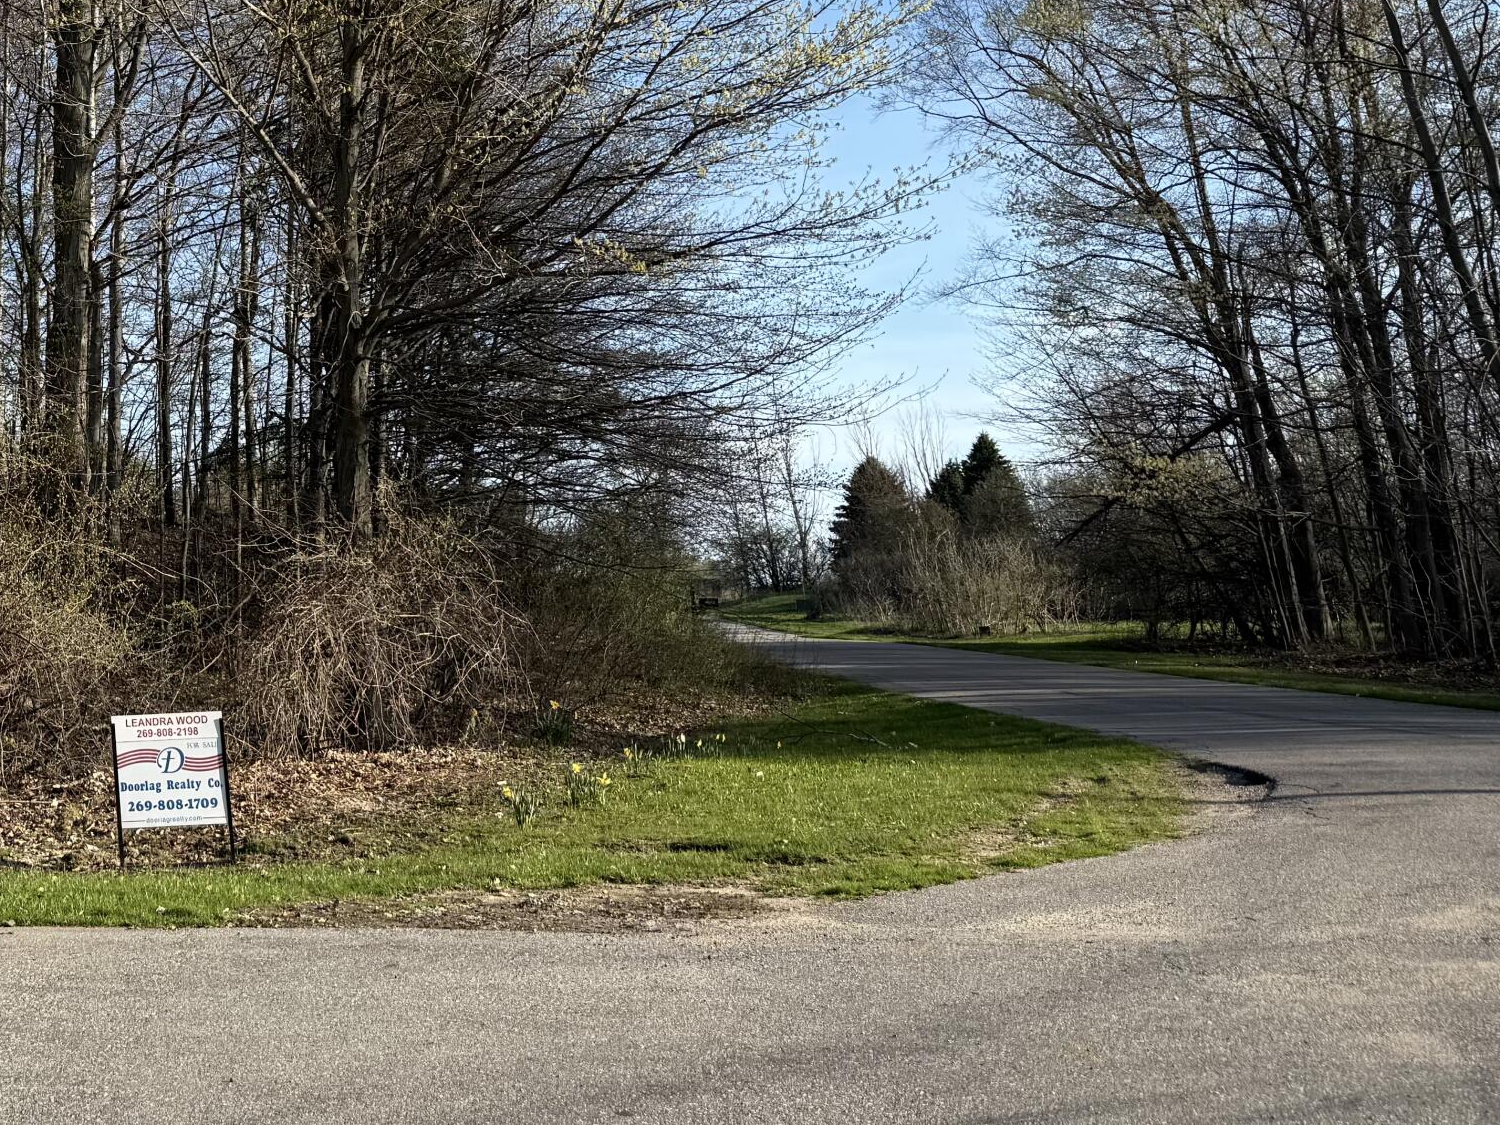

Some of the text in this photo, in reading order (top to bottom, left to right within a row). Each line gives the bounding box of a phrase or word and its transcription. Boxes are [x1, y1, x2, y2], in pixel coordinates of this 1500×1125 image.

[125, 715, 208, 728] LEANDRA WOOD
[137, 727, 199, 738] 269-808-2198
[120, 778, 223, 793] Doorlag Realty Co.
[128, 797, 218, 812] 269-808-1709
[146, 816, 203, 824] doorlagrealty.com
